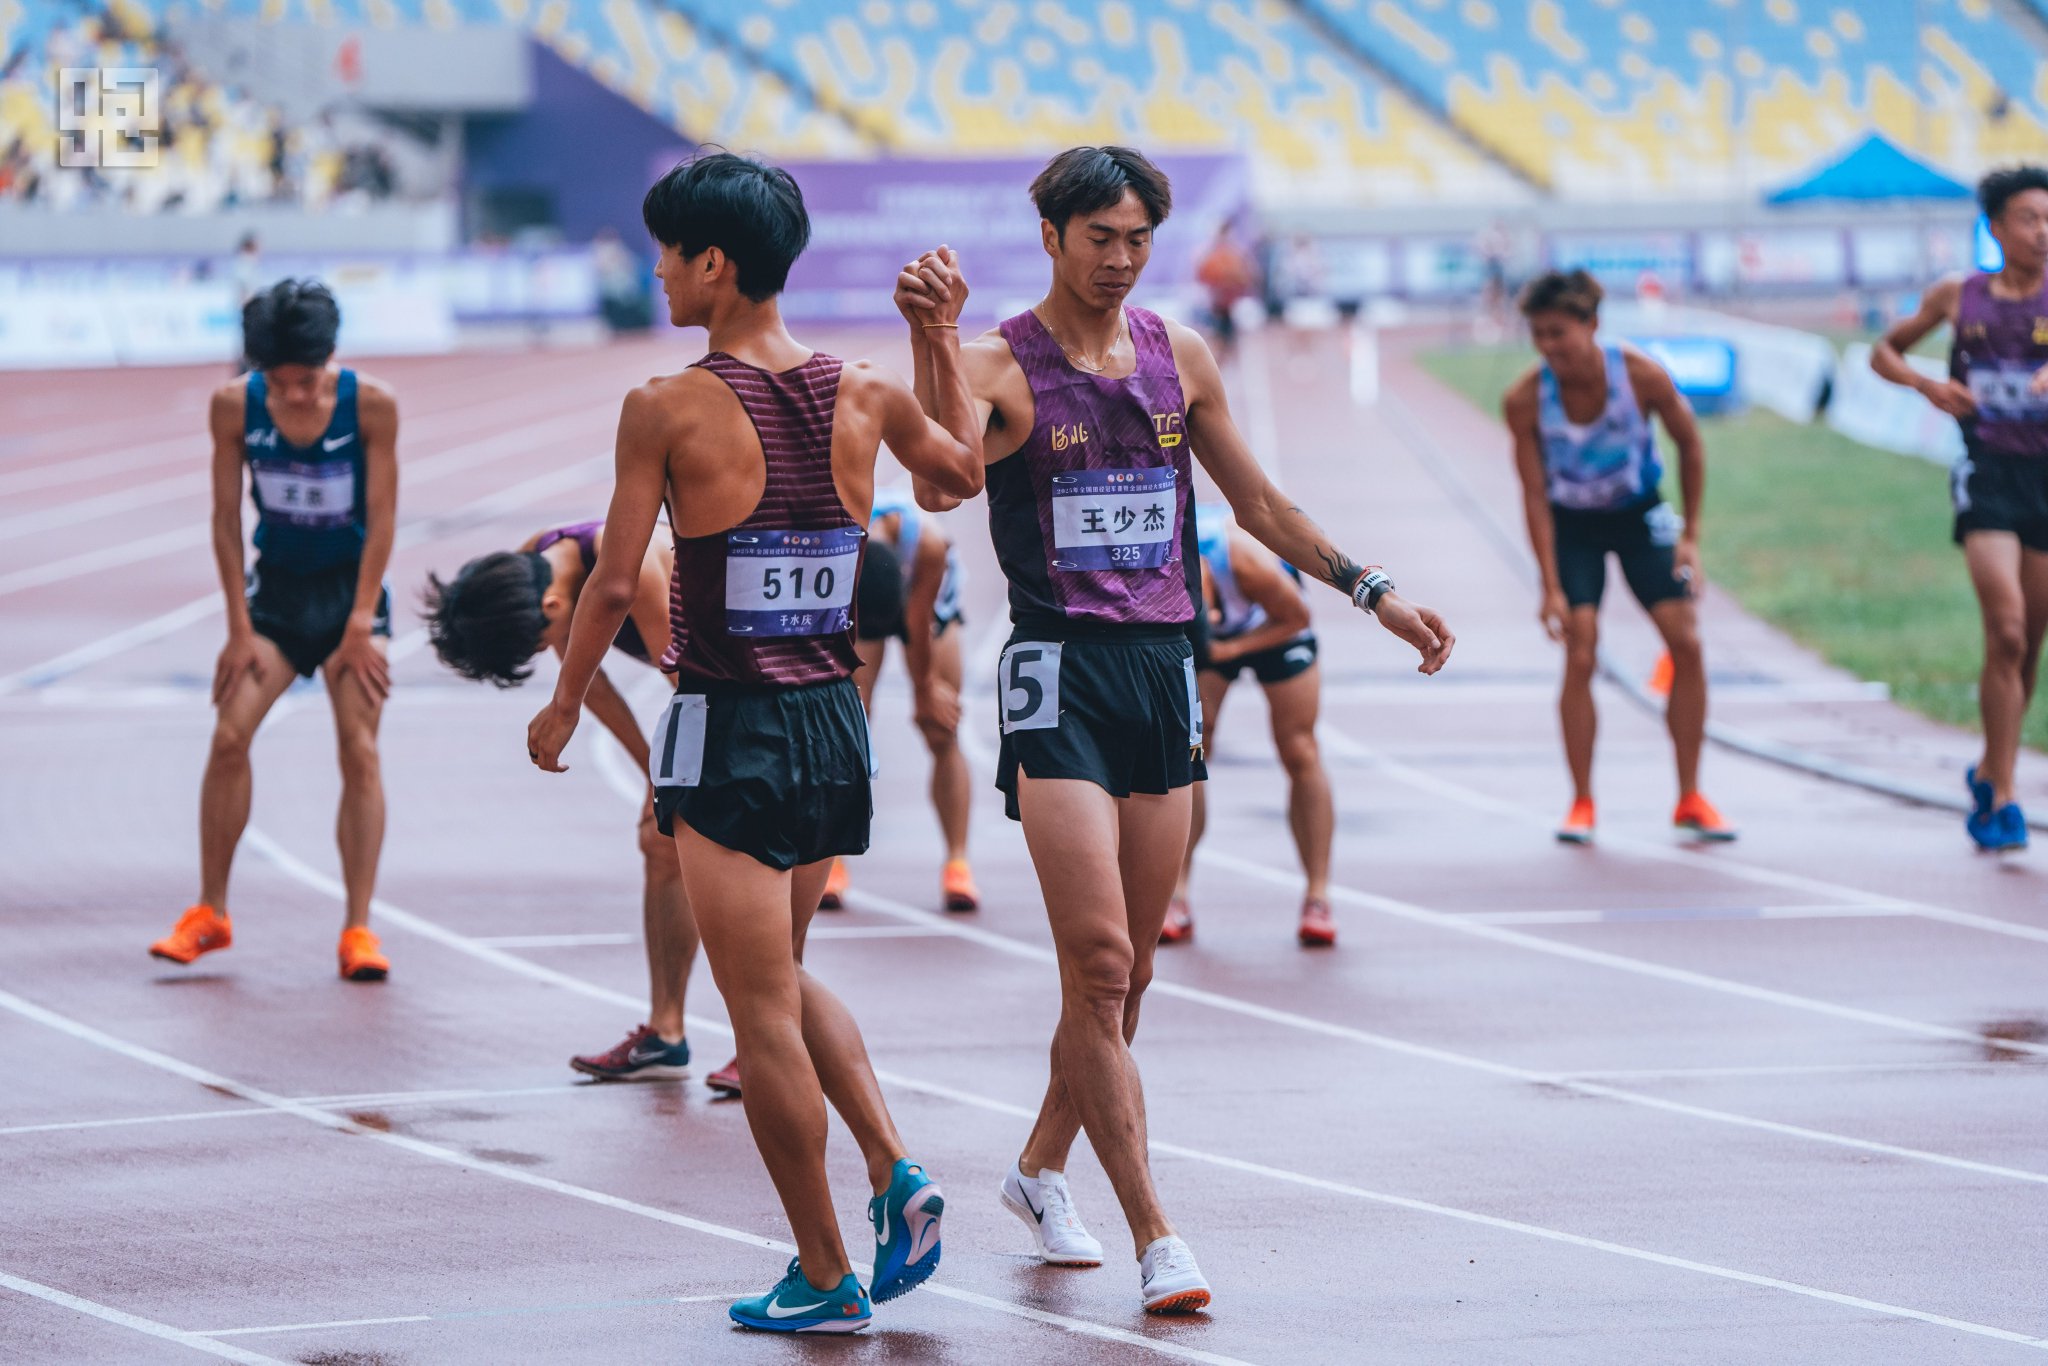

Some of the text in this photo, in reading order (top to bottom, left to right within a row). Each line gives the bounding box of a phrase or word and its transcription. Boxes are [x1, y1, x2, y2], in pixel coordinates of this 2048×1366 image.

[1153, 413, 1179, 432] TF
[1081, 504, 1165, 533] 王少杰
[1111, 546, 1140, 561] 325
[763, 567, 834, 600] 510
[1008, 650, 1043, 722] 5
